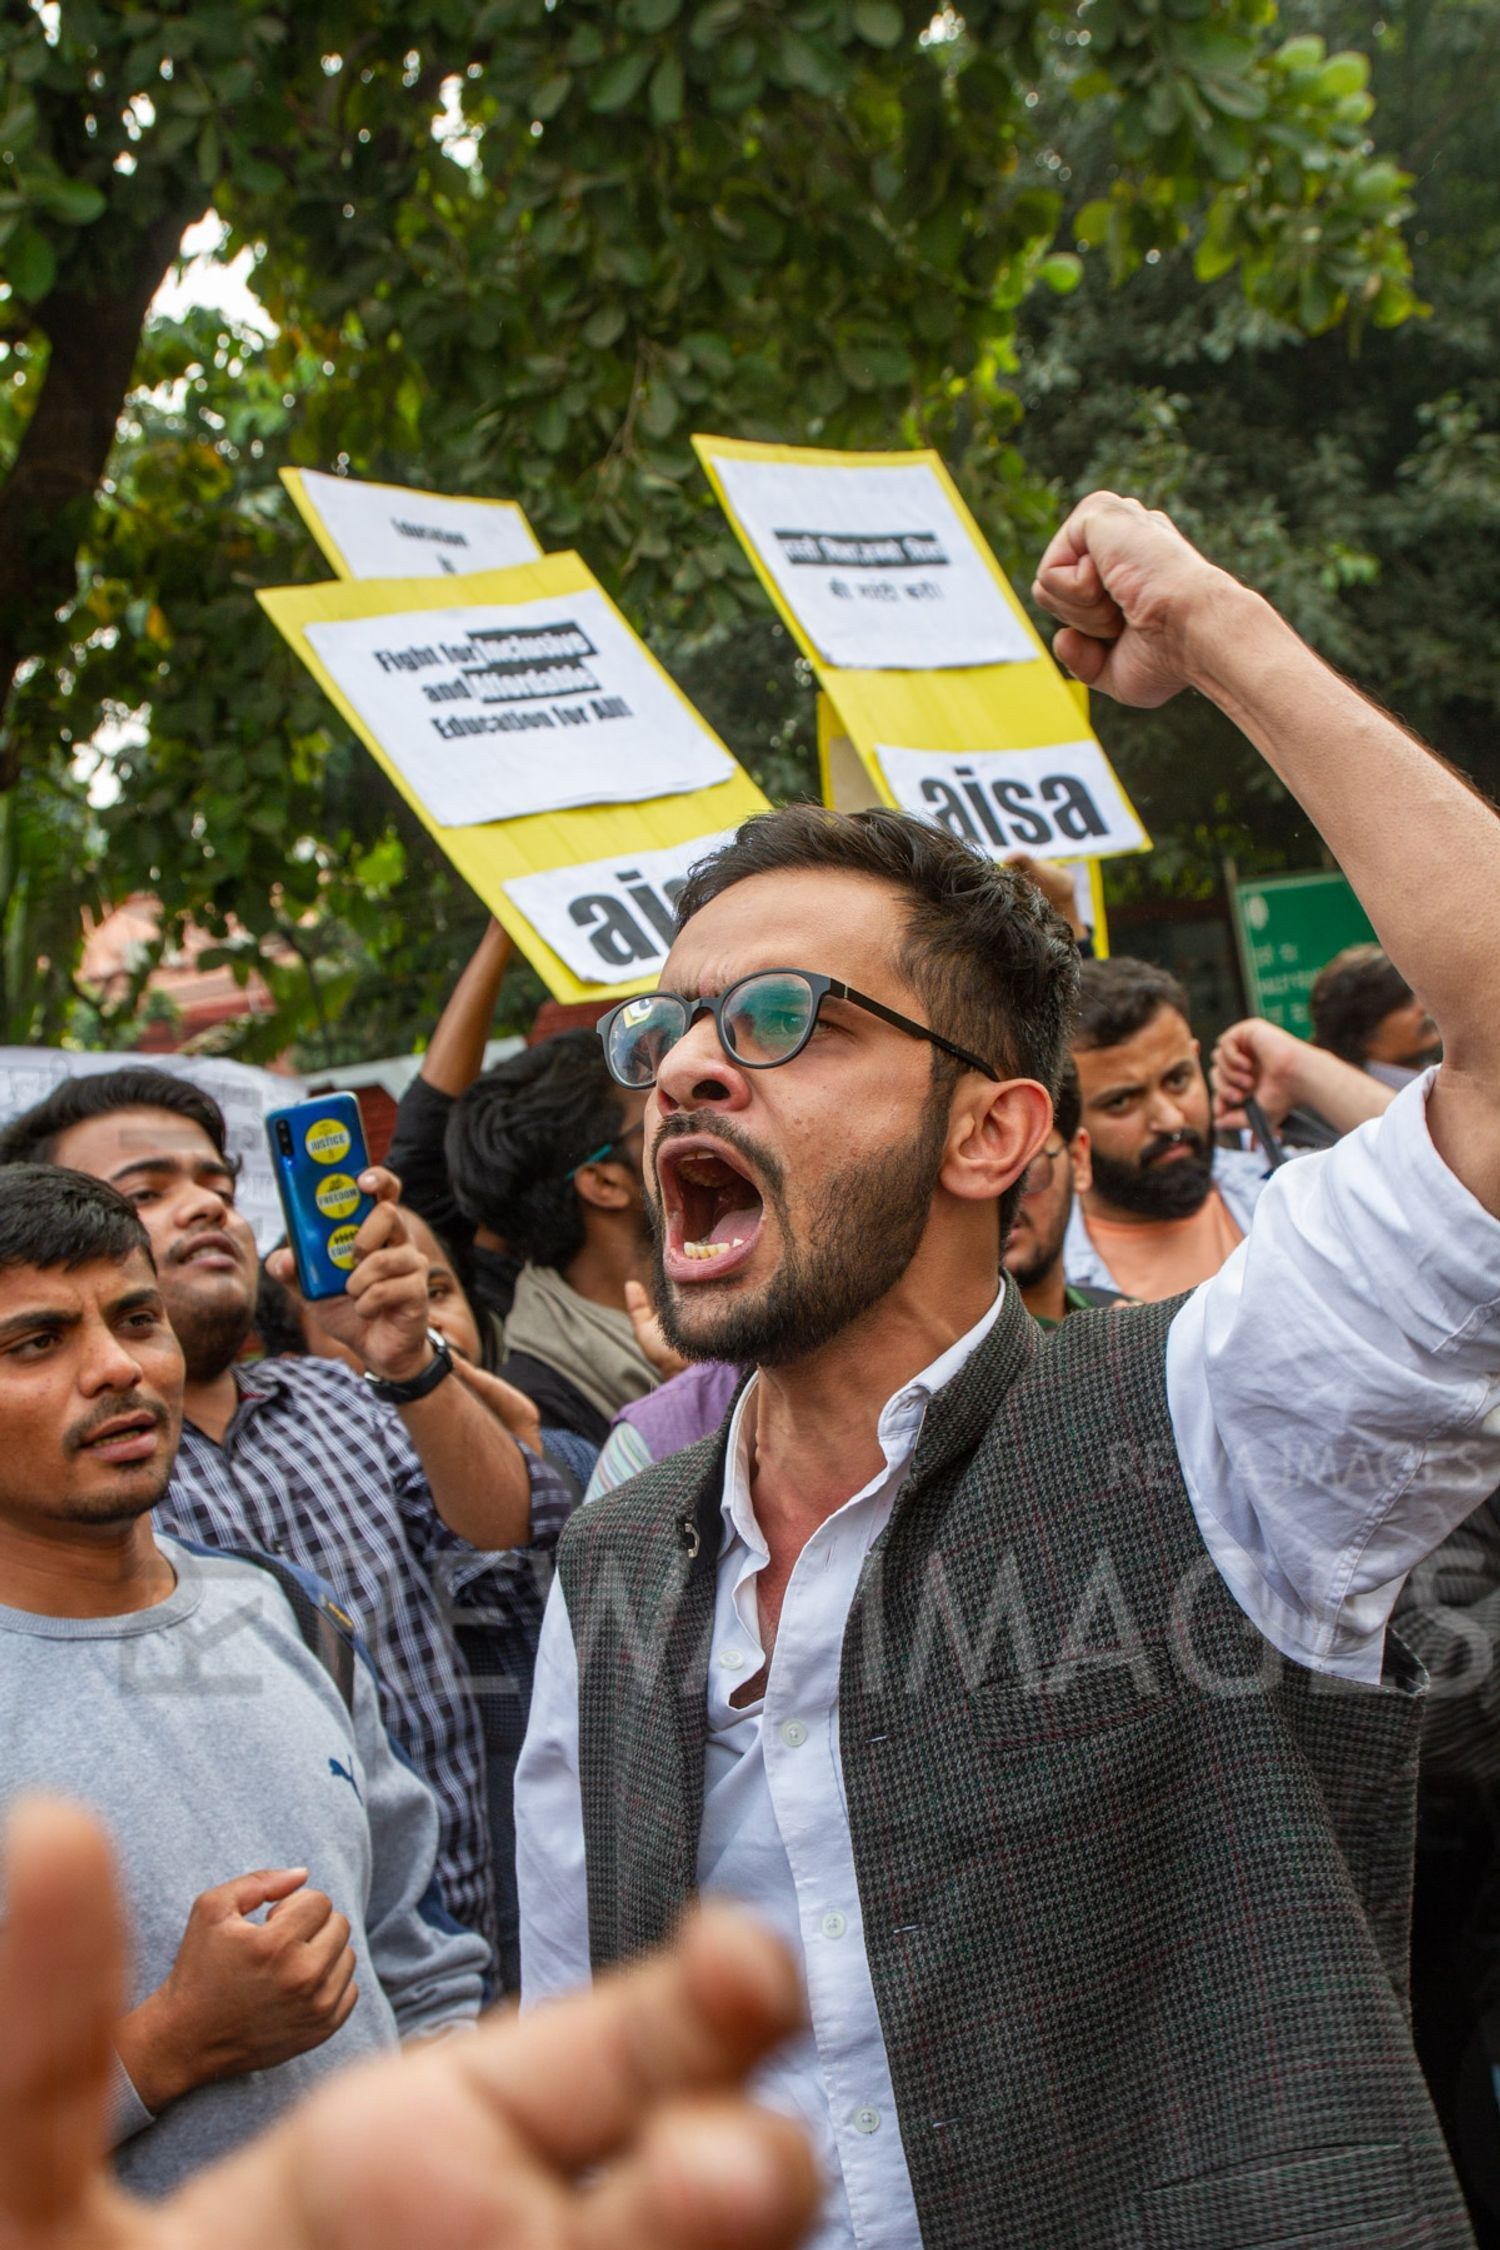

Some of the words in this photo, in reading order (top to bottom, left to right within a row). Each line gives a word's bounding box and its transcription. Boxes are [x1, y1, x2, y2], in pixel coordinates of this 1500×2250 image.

[374, 645, 443, 673] Fight
[439, 643, 479, 663] for
[422, 677, 472, 703] and
[431, 709, 555, 740] Education
[552, 705, 590, 726] for
[921, 767, 1110, 846] aisa
[311, 1134, 346, 1151] JUSTICE
[319, 1187, 358, 1206] FREEDOM
